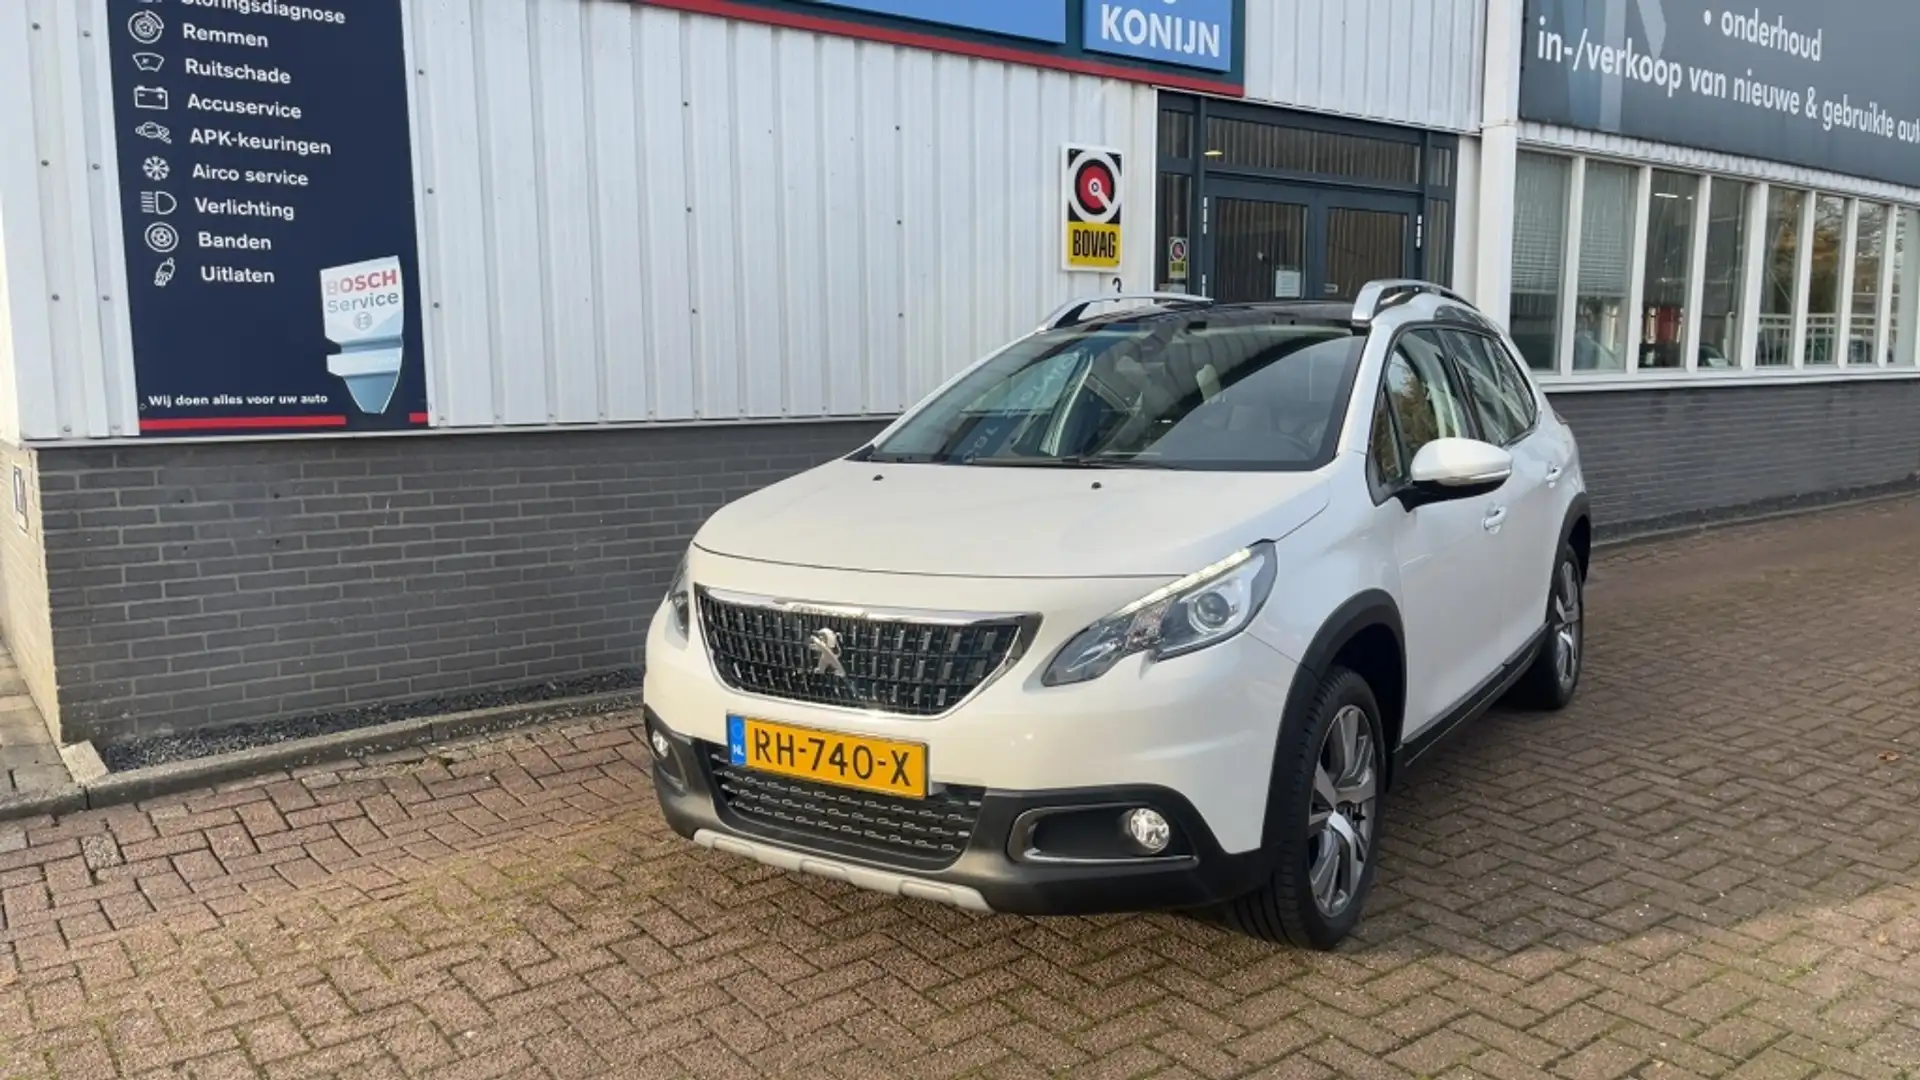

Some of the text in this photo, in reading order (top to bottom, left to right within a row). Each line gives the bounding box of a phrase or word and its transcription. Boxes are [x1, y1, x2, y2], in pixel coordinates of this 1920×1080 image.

[181, 0, 346, 24] oringsdiagnose
[183, 22, 269, 48] Remmen
[1101, 3, 1220, 58] KONIJN
[1721, 8, 1823, 62] onderhoud
[186, 58, 291, 84] Ruitschade
[1538, 15, 1683, 98] in-/verkoop
[1689, 66, 1727, 99] van
[1733, 69, 1800, 115] nieuwe
[1805, 86, 1818, 119] &
[1822, 93, 1895, 138] gebruikte
[187, 93, 302, 119] Accuservice
[189, 128, 332, 155] APK-keuringen
[192, 163, 309, 186] Airco service
[195, 196, 295, 221] Verlichting
[198, 231, 272, 250] Banden
[1072, 229, 1117, 259] BOVAG
[201, 265, 275, 283] Uitlaten
[326, 269, 398, 296] BOSCH
[327, 292, 399, 313] Service
[148, 394, 328, 408] Wij doen alles voor uw auto
[732, 727, 912, 787] NL RH-740-X
